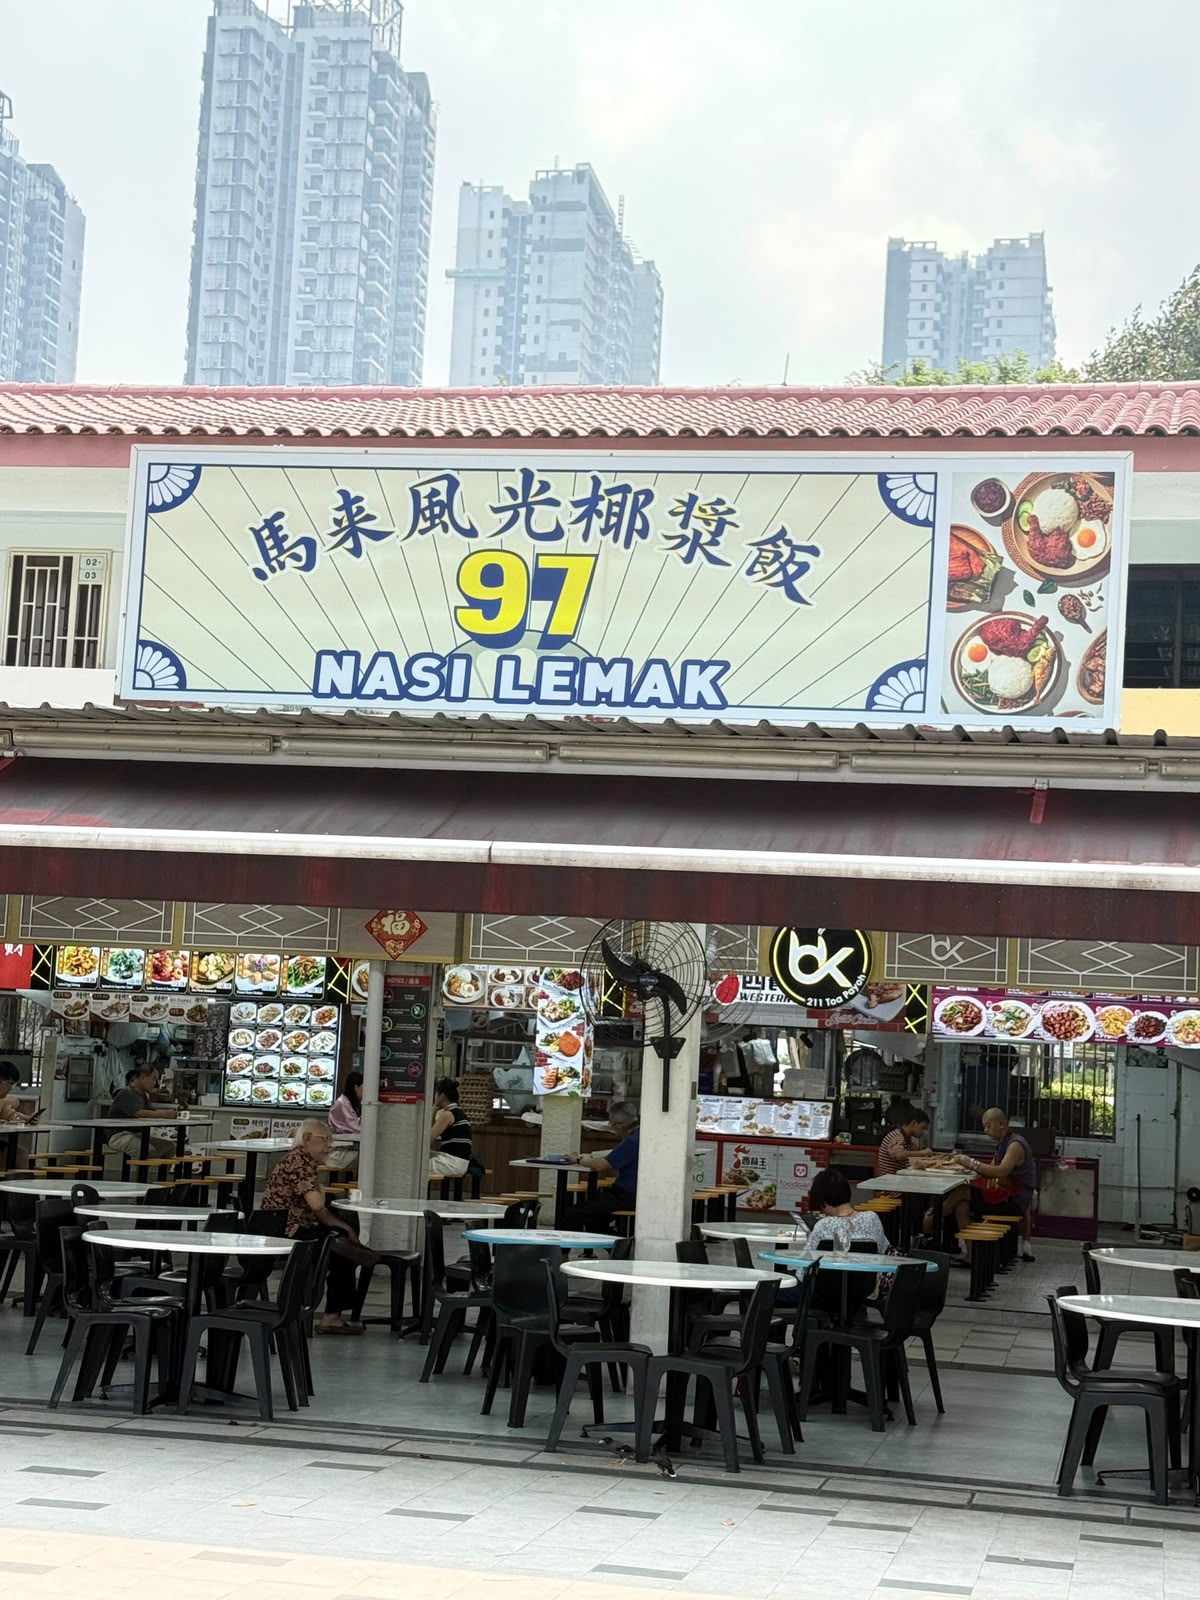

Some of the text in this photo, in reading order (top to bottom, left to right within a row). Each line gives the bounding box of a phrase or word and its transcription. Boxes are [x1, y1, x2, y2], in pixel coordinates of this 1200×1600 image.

[84, 571, 97, 579] 03
[454, 548, 600, 650] 97
[313, 649, 731, 710] NASI LEMAK
[806, 997, 823, 1007] 211
[824, 996, 844, 1007] Toa
[842, 974, 867, 999] Payoh
